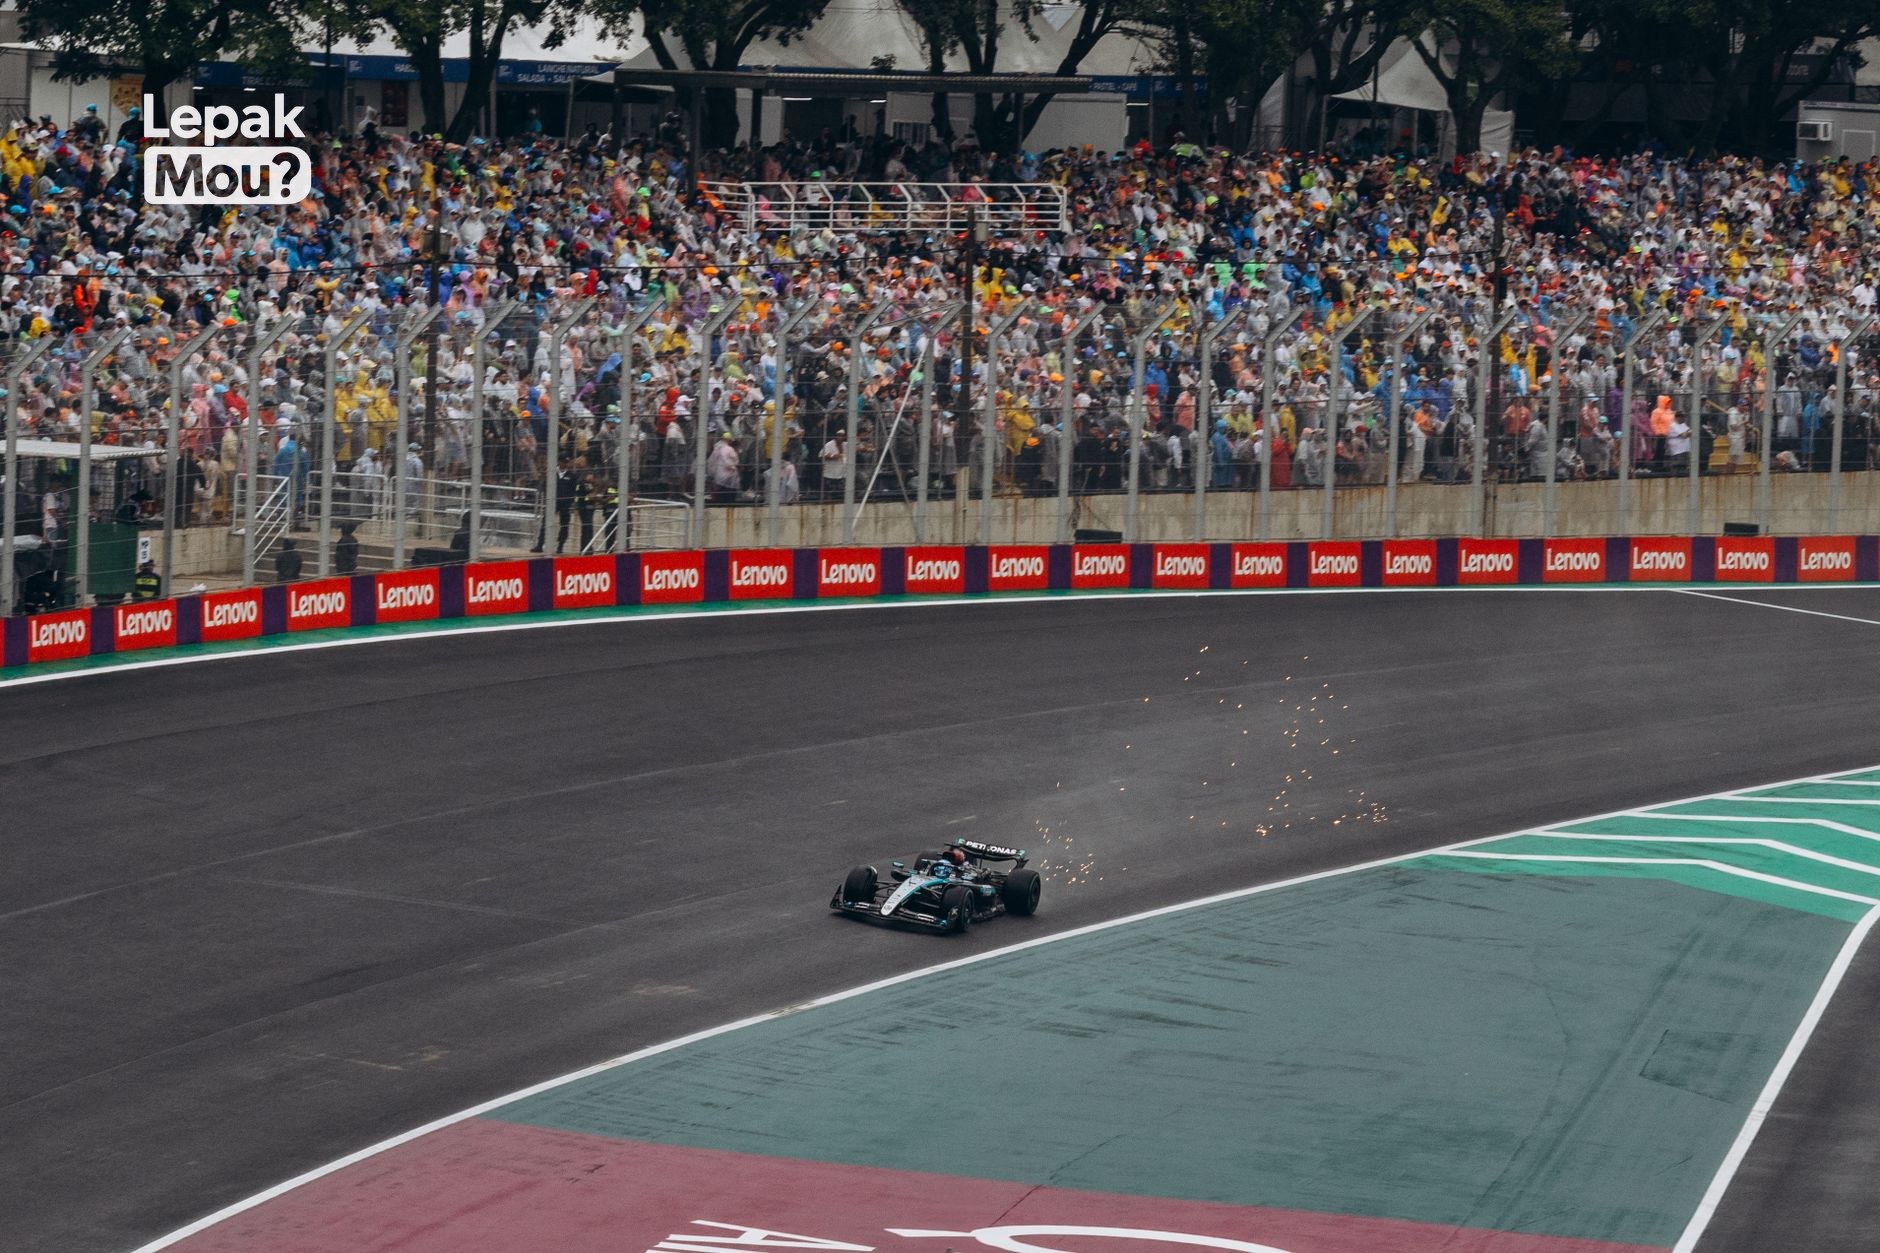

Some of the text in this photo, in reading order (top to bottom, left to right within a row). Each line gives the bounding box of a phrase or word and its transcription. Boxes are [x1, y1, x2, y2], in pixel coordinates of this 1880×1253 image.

[908, 556, 960, 580] Lenovo
[992, 554, 1043, 577] Lenovo
[1075, 552, 1124, 575] Lenovo
[1157, 552, 1205, 575] Lenovo
[1235, 552, 1282, 575] Lenovo
[1312, 551, 1357, 574] Lenovo
[1386, 552, 1431, 573] Lenovo
[1462, 550, 1512, 572] Lenovo
[1547, 549, 1599, 571] Lenovo
[1633, 547, 1685, 569] Lenovo
[1719, 548, 1768, 569] Lenovo
[1801, 549, 1850, 569] Lenovo
[645, 566, 698, 590] Lenovo
[733, 561, 787, 585] Lenovo
[822, 559, 875, 583] Lenovo
[469, 577, 522, 602] Lenovo
[557, 571, 610, 596] Lenovo
[291, 591, 344, 617] Lenovo
[379, 583, 433, 608] Lenovo
[119, 610, 171, 636] Lenovo
[205, 601, 256, 627] Lenovo
[32, 620, 85, 647] Lenovo
